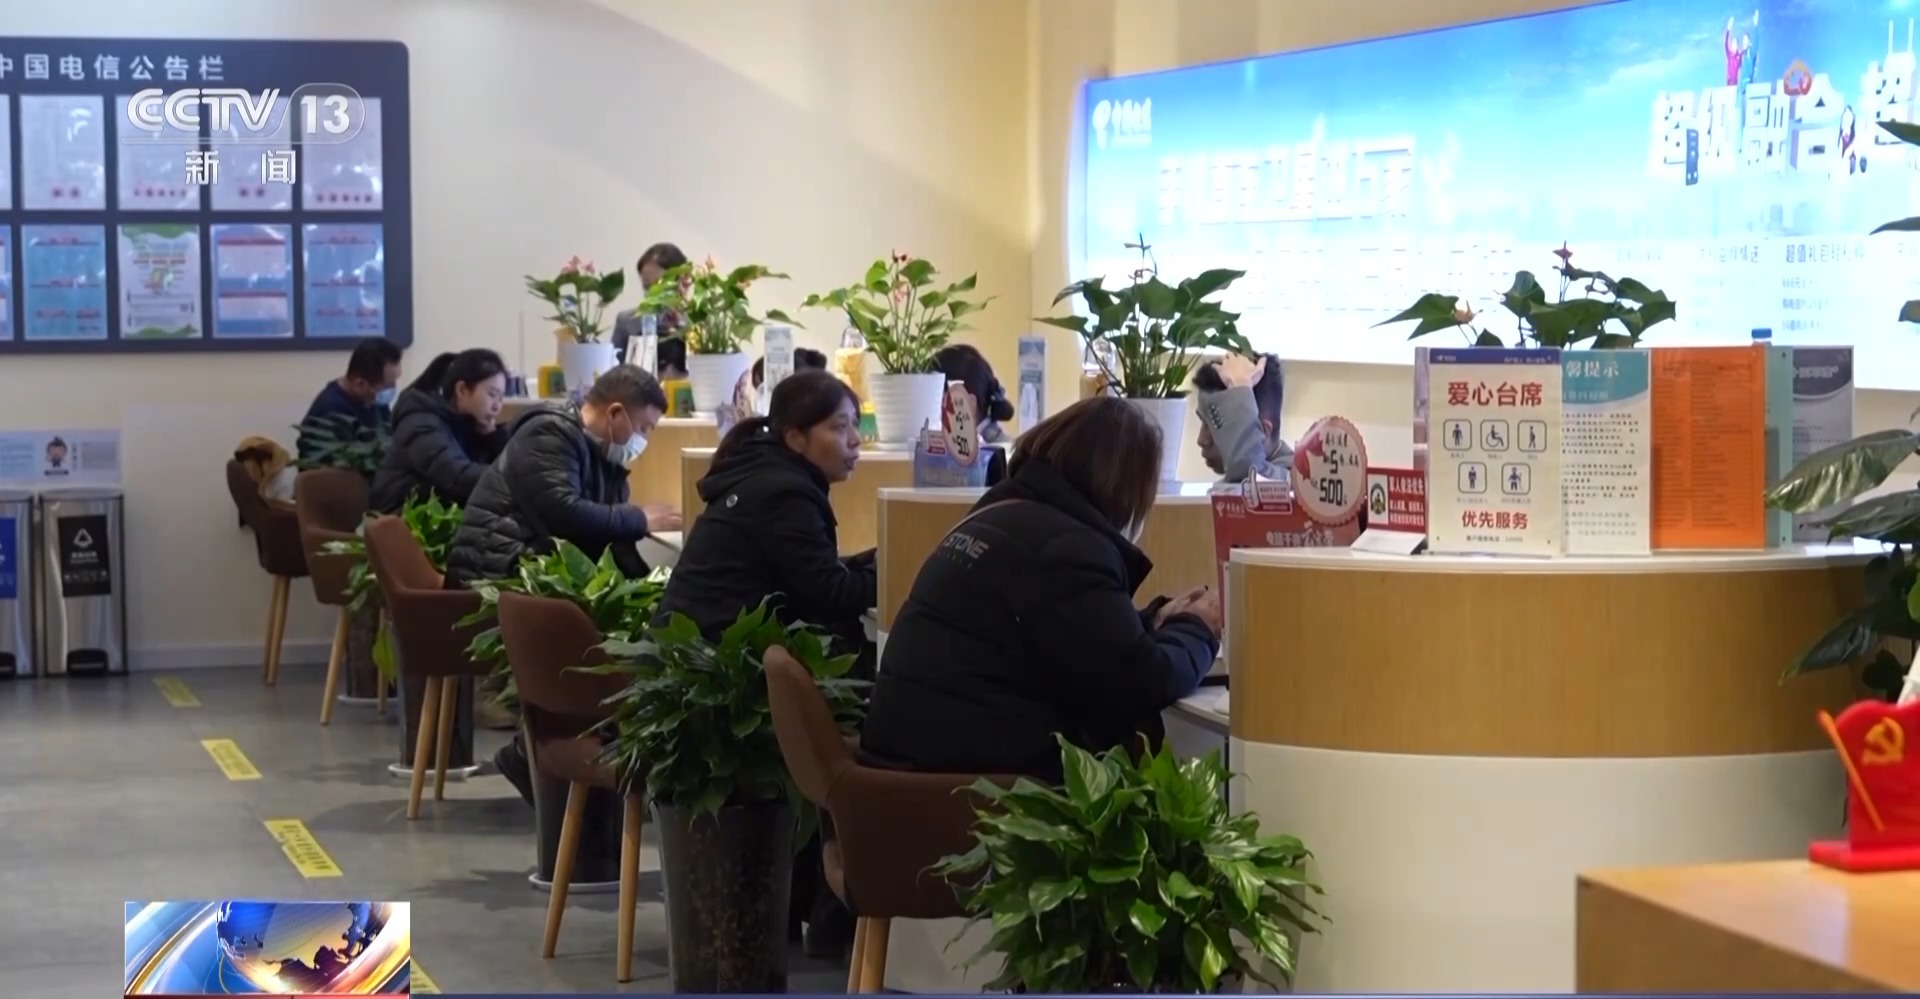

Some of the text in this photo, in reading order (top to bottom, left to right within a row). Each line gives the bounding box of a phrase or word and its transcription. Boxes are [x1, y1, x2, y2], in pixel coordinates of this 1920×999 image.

[1447, 381, 1543, 407] 爱心台席
[1319, 478, 1344, 506] 500
[1461, 510, 1528, 530] 优先服务
